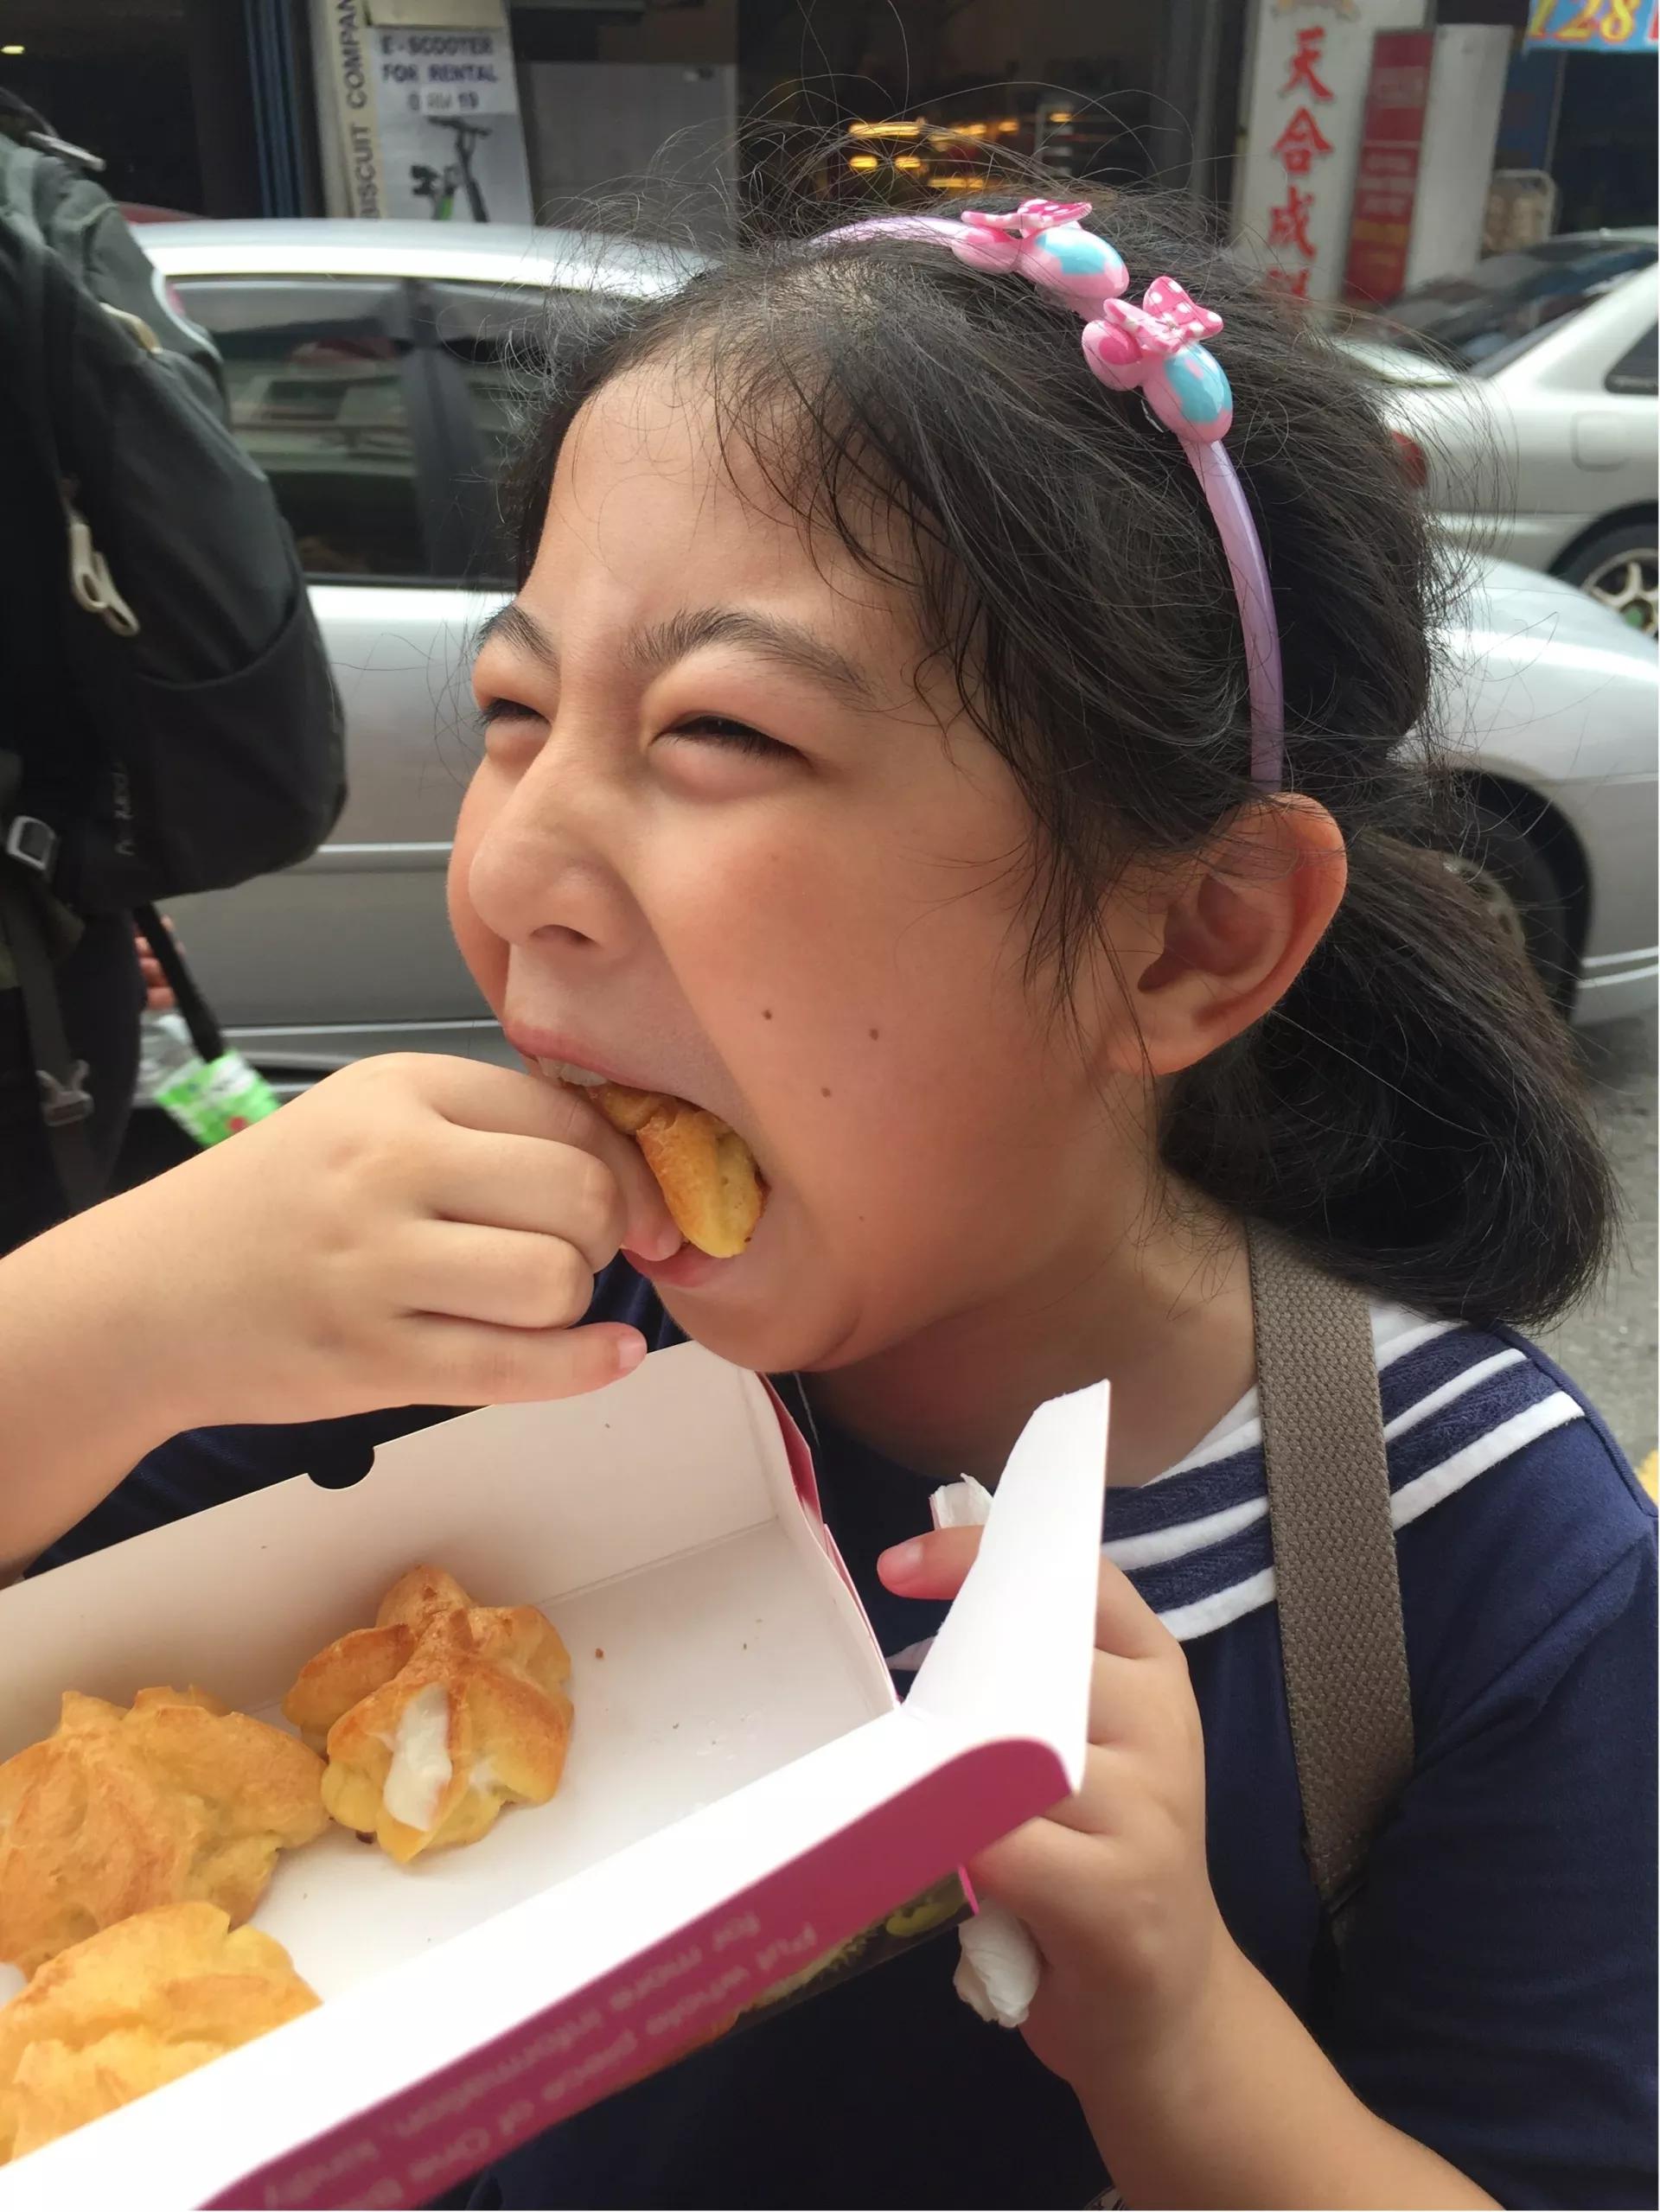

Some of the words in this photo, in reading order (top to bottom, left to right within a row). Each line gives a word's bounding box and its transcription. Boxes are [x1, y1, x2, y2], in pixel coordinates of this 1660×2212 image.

[382, 64, 418, 82] FOR
[428, 64, 499, 83] RENTAL
[709, 1911, 761, 1953] for
[609, 1946, 702, 2010] more
[646, 1966, 749, 2037] whole
[496, 2097, 535, 2133] of
